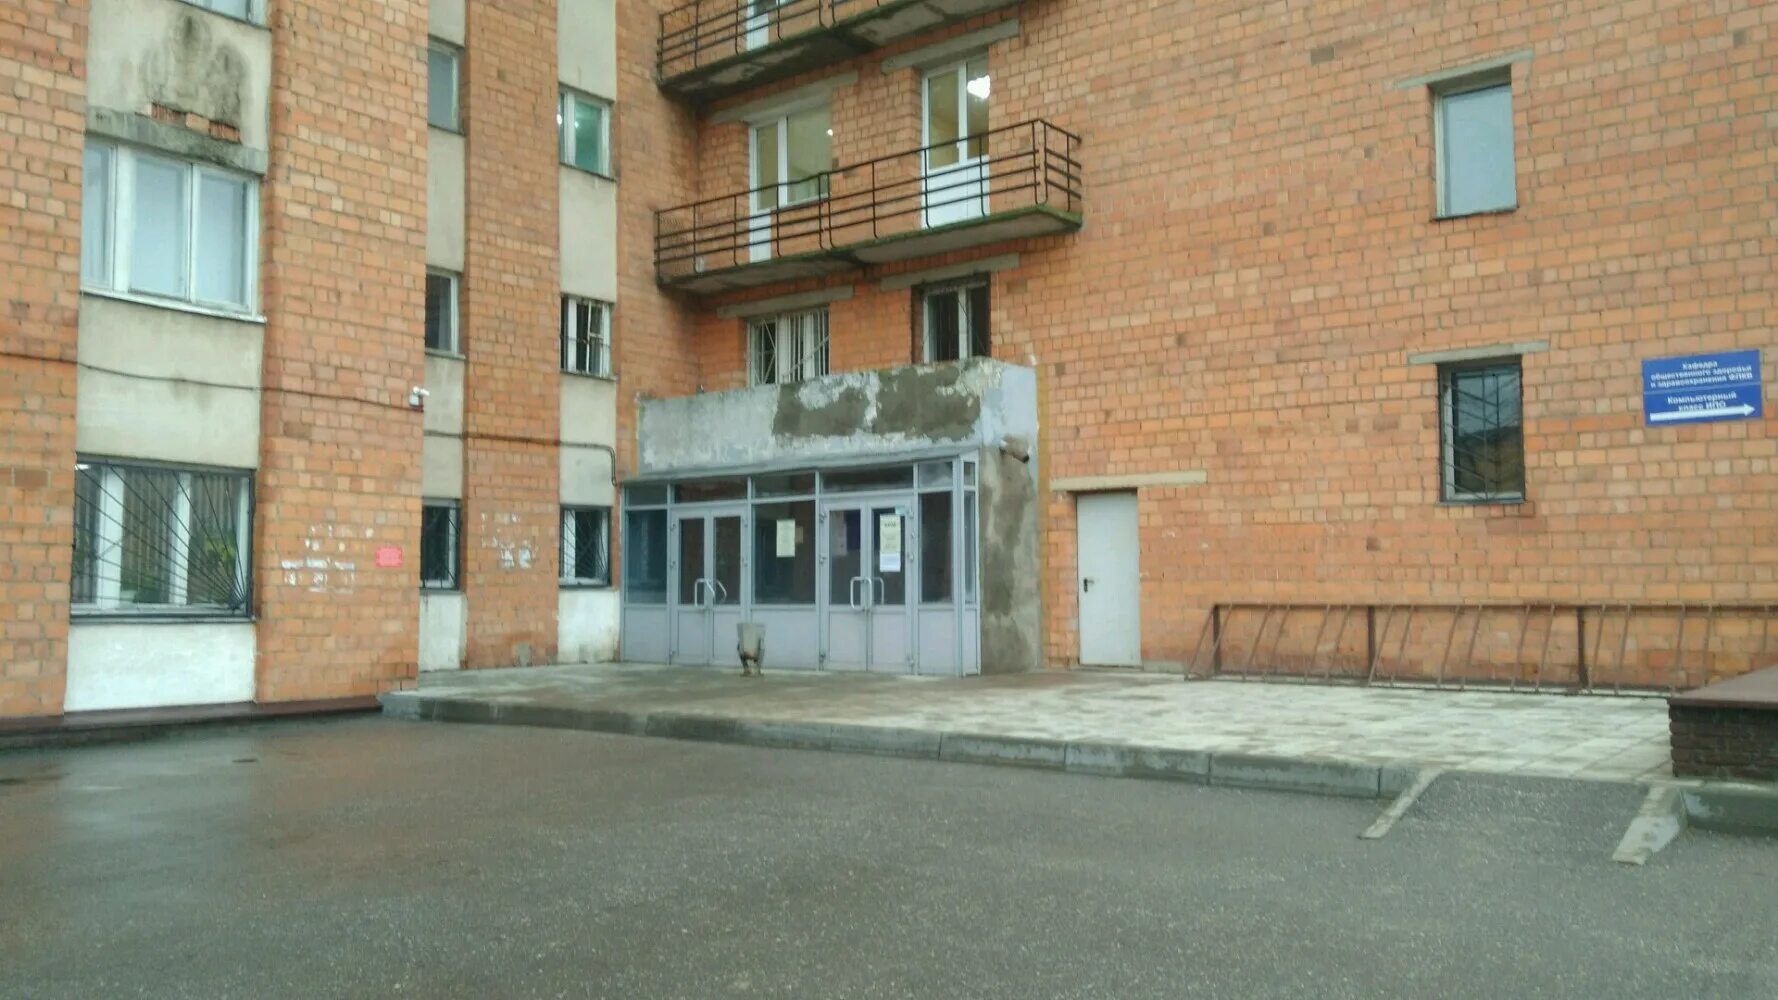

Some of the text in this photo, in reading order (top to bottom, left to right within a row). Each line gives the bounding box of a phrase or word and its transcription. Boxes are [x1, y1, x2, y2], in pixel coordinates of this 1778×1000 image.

[1682, 361, 1718, 370] Кафедра
[1650, 365, 1752, 380] общественного здоровья
[1657, 376, 1727, 387] здравоохранения
[1667, 391, 1737, 404] Компьютерный
